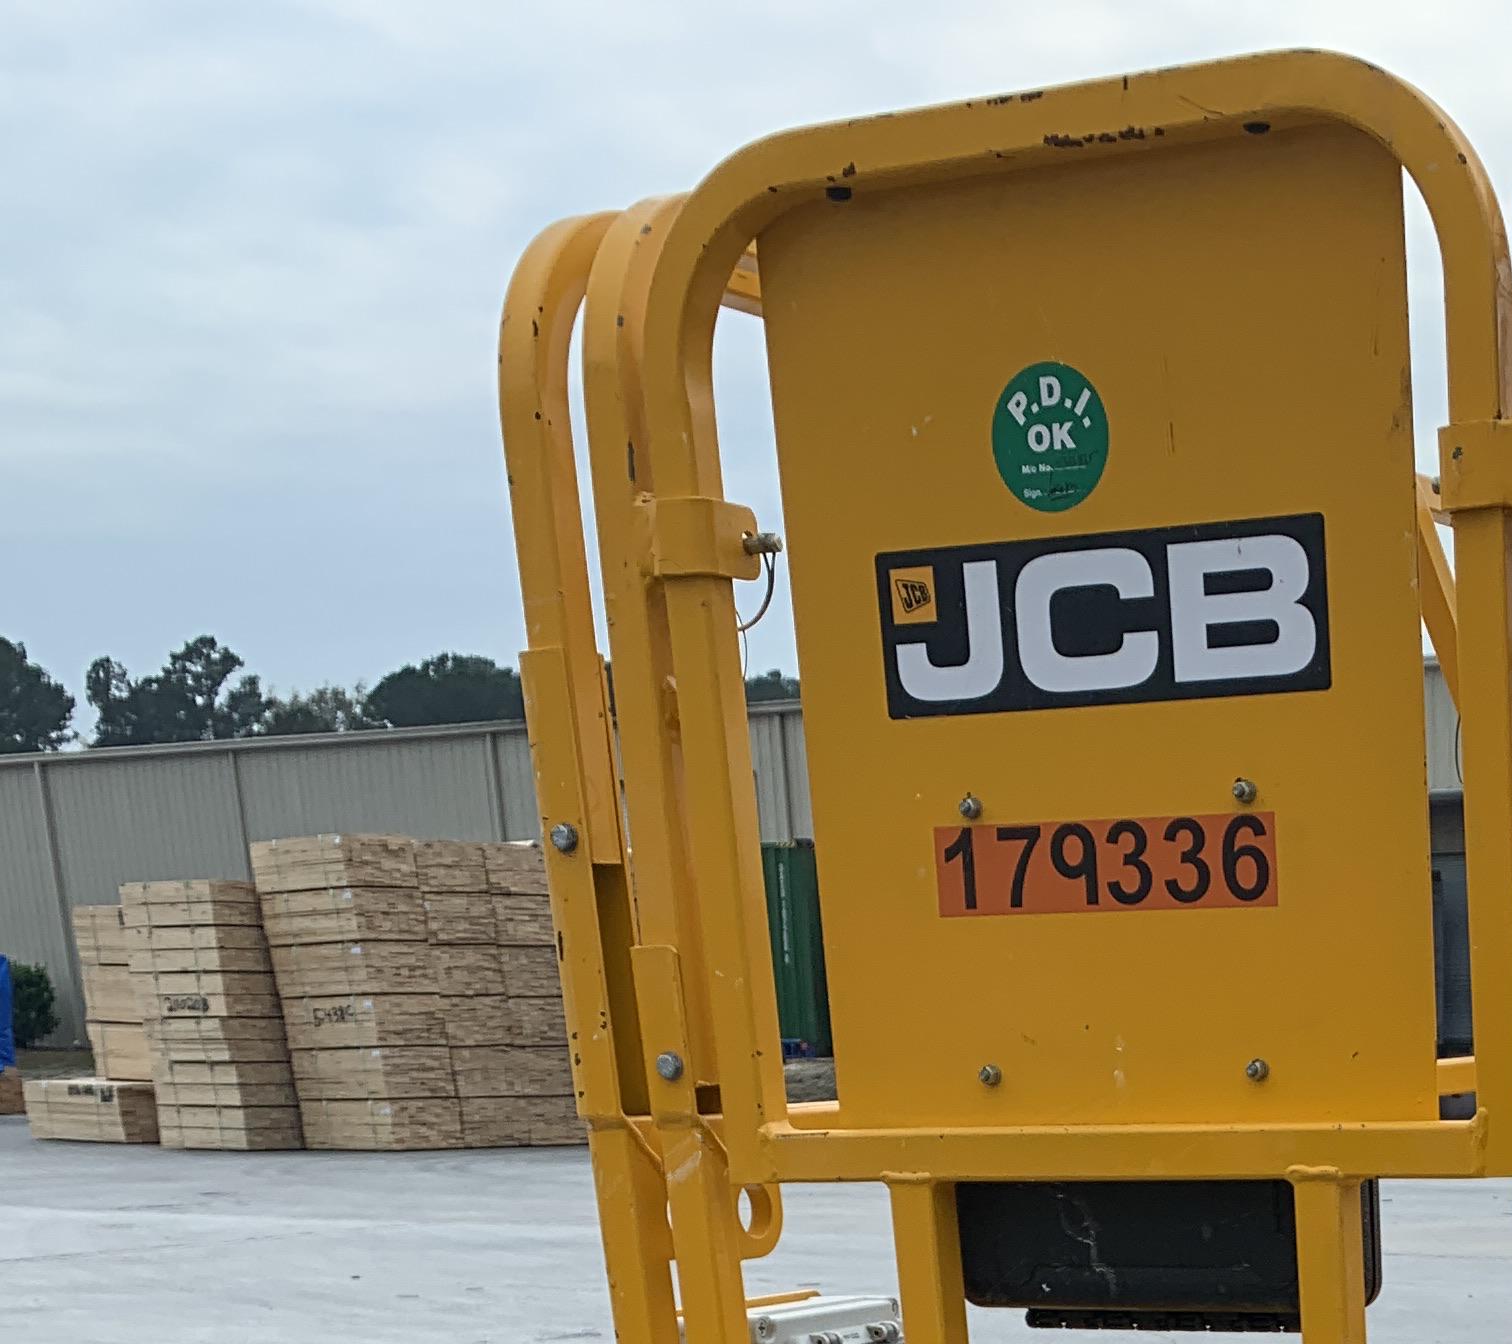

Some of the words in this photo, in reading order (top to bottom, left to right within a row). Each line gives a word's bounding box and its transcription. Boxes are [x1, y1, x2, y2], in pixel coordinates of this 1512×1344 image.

[1007, 376, 1091, 428] P.D.I.
[1027, 421, 1076, 453] OK
[896, 534, 1316, 701] JCB
[902, 583, 928, 609] JCB
[943, 814, 1271, 910] 179336
